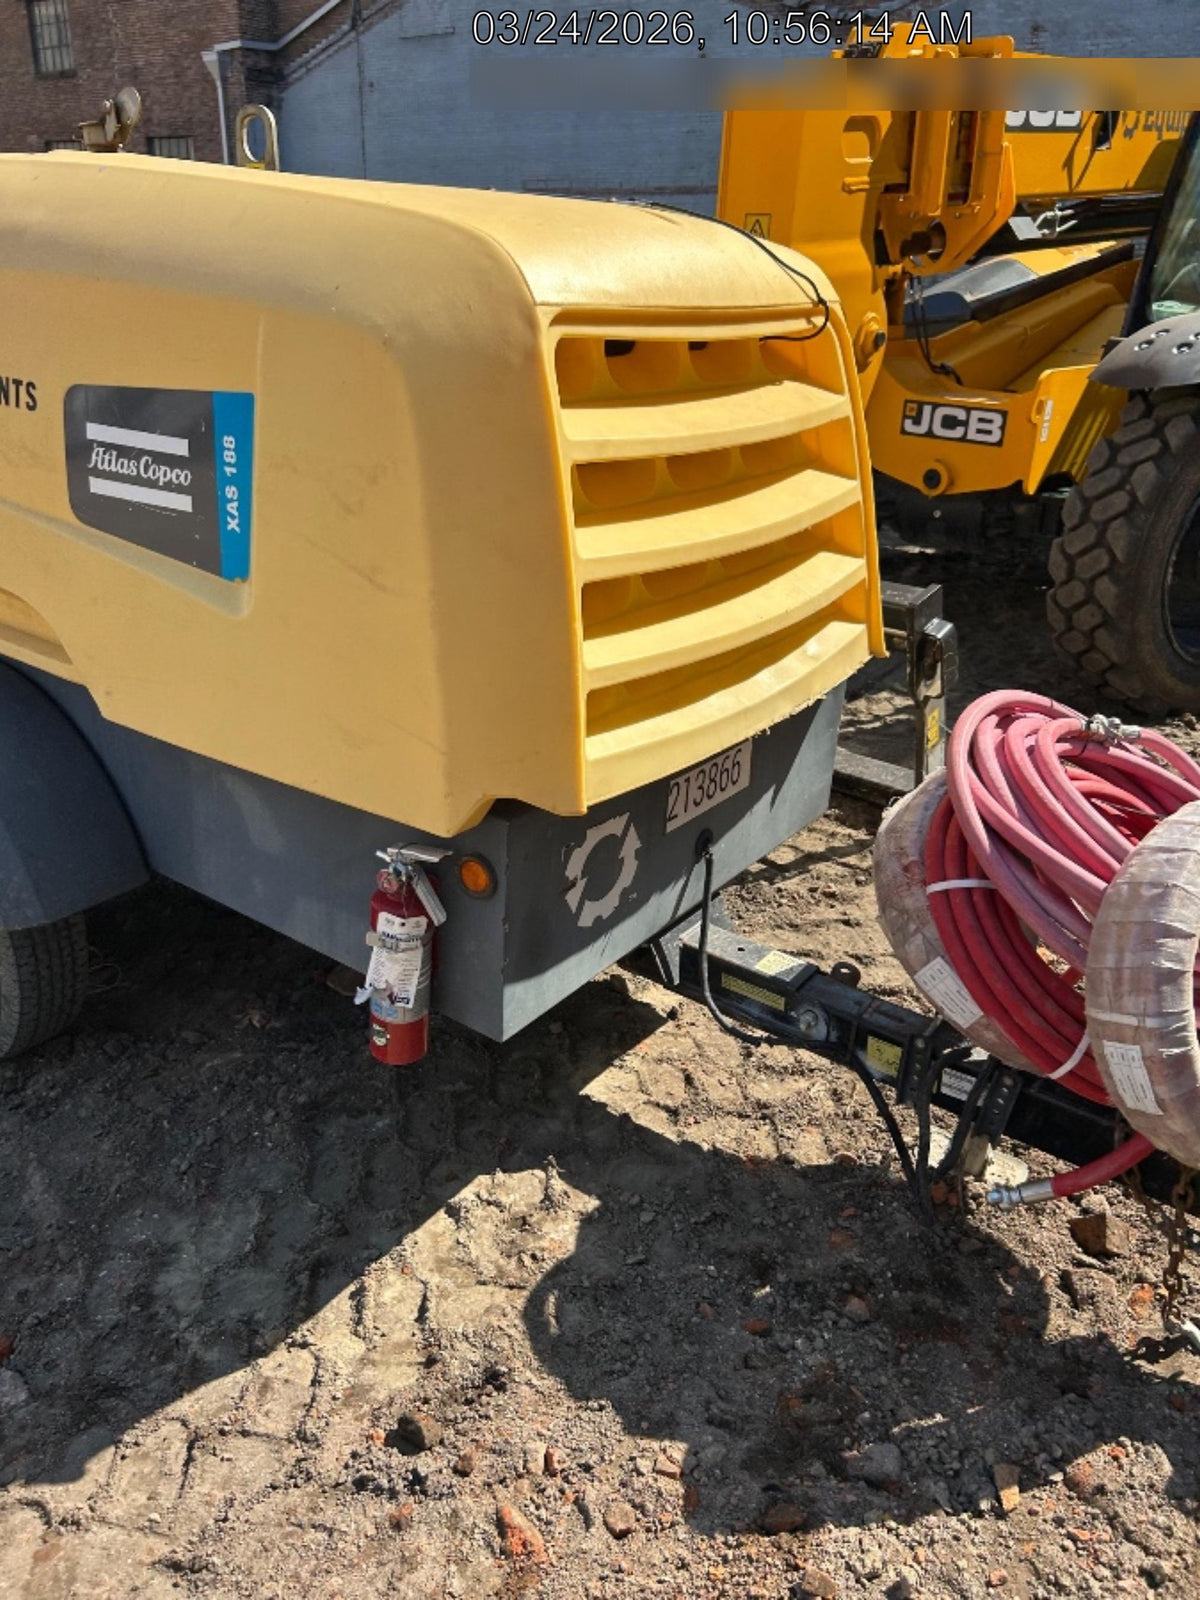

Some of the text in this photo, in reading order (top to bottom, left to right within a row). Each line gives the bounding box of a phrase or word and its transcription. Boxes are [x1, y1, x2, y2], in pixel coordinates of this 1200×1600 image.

[0, 375, 37, 411] NTS
[903, 404, 1004, 444] JCB
[87, 444, 192, 486] Atlas Copco
[222, 435, 240, 533] XAS 188
[668, 747, 742, 822] 213866
